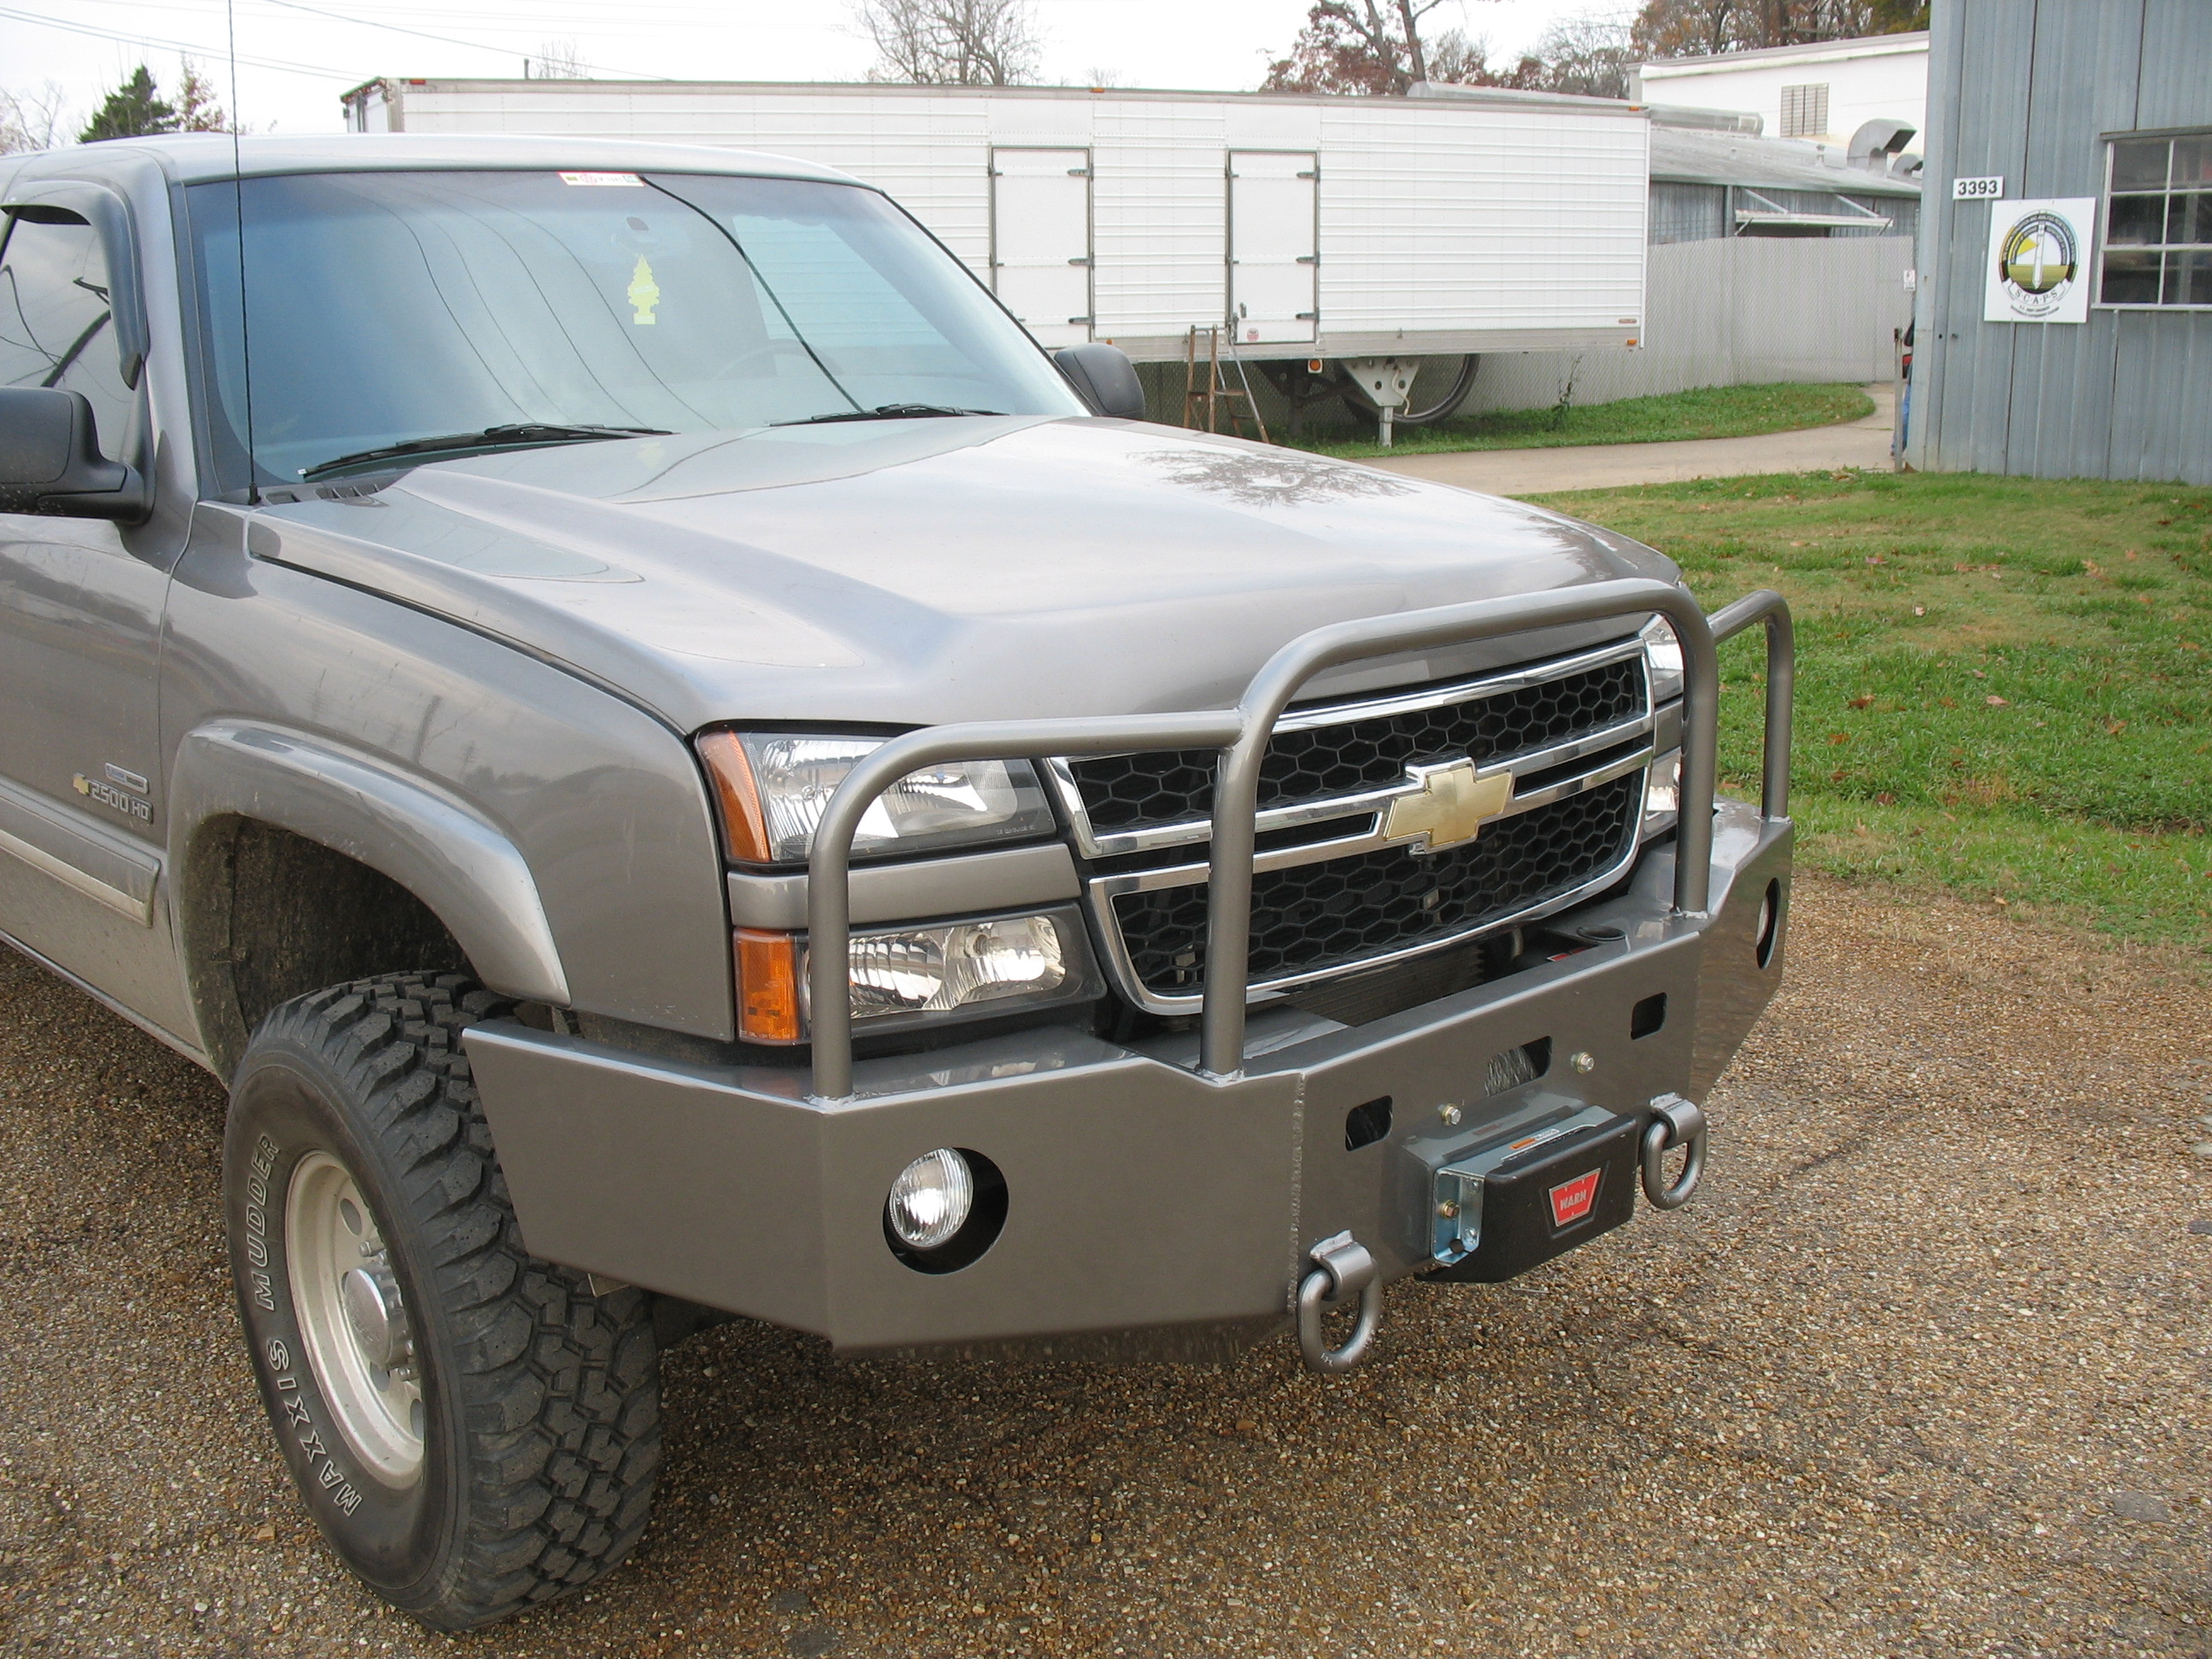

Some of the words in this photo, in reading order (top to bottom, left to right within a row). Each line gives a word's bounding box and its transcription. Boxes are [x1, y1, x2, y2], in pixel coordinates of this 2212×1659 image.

[1958, 179, 1998, 195] 3393
[90, 782, 130, 813] 2500
[131, 800, 149, 820] HD
[1560, 1189, 1586, 1210] WARN
[246, 1134, 279, 1312] MUDDER
[267, 1338, 363, 1517] MAXXIS
